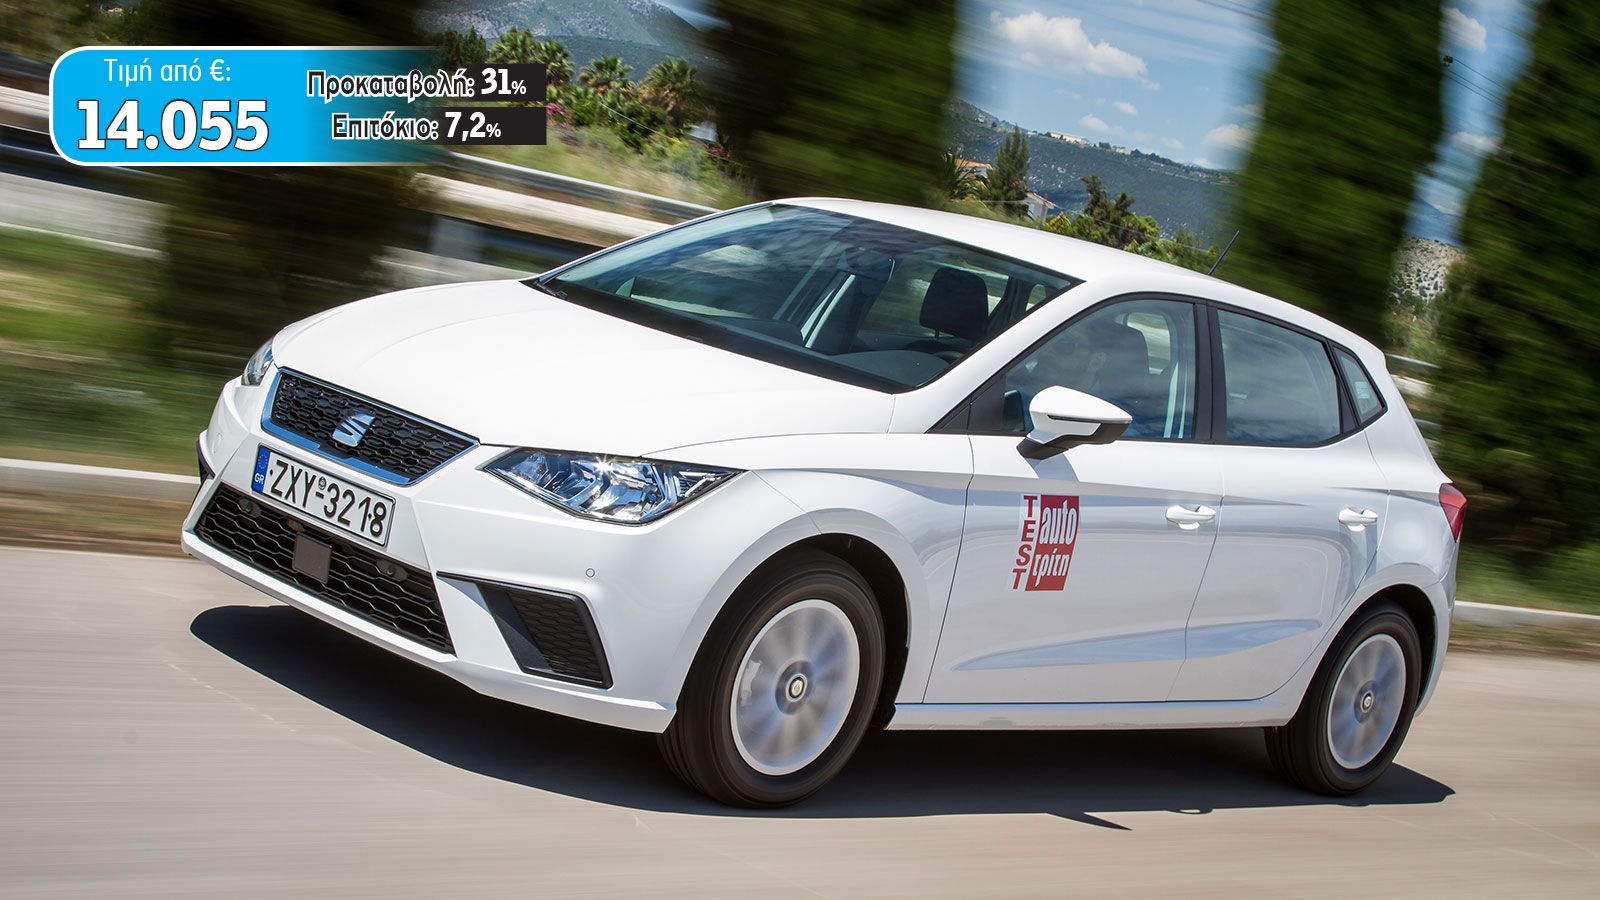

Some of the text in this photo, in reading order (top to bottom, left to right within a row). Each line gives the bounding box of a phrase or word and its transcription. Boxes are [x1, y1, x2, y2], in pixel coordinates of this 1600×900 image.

[254, 472, 265, 485] GR
[1012, 495, 1038, 590] TEST
[1039, 499, 1078, 545] auto
